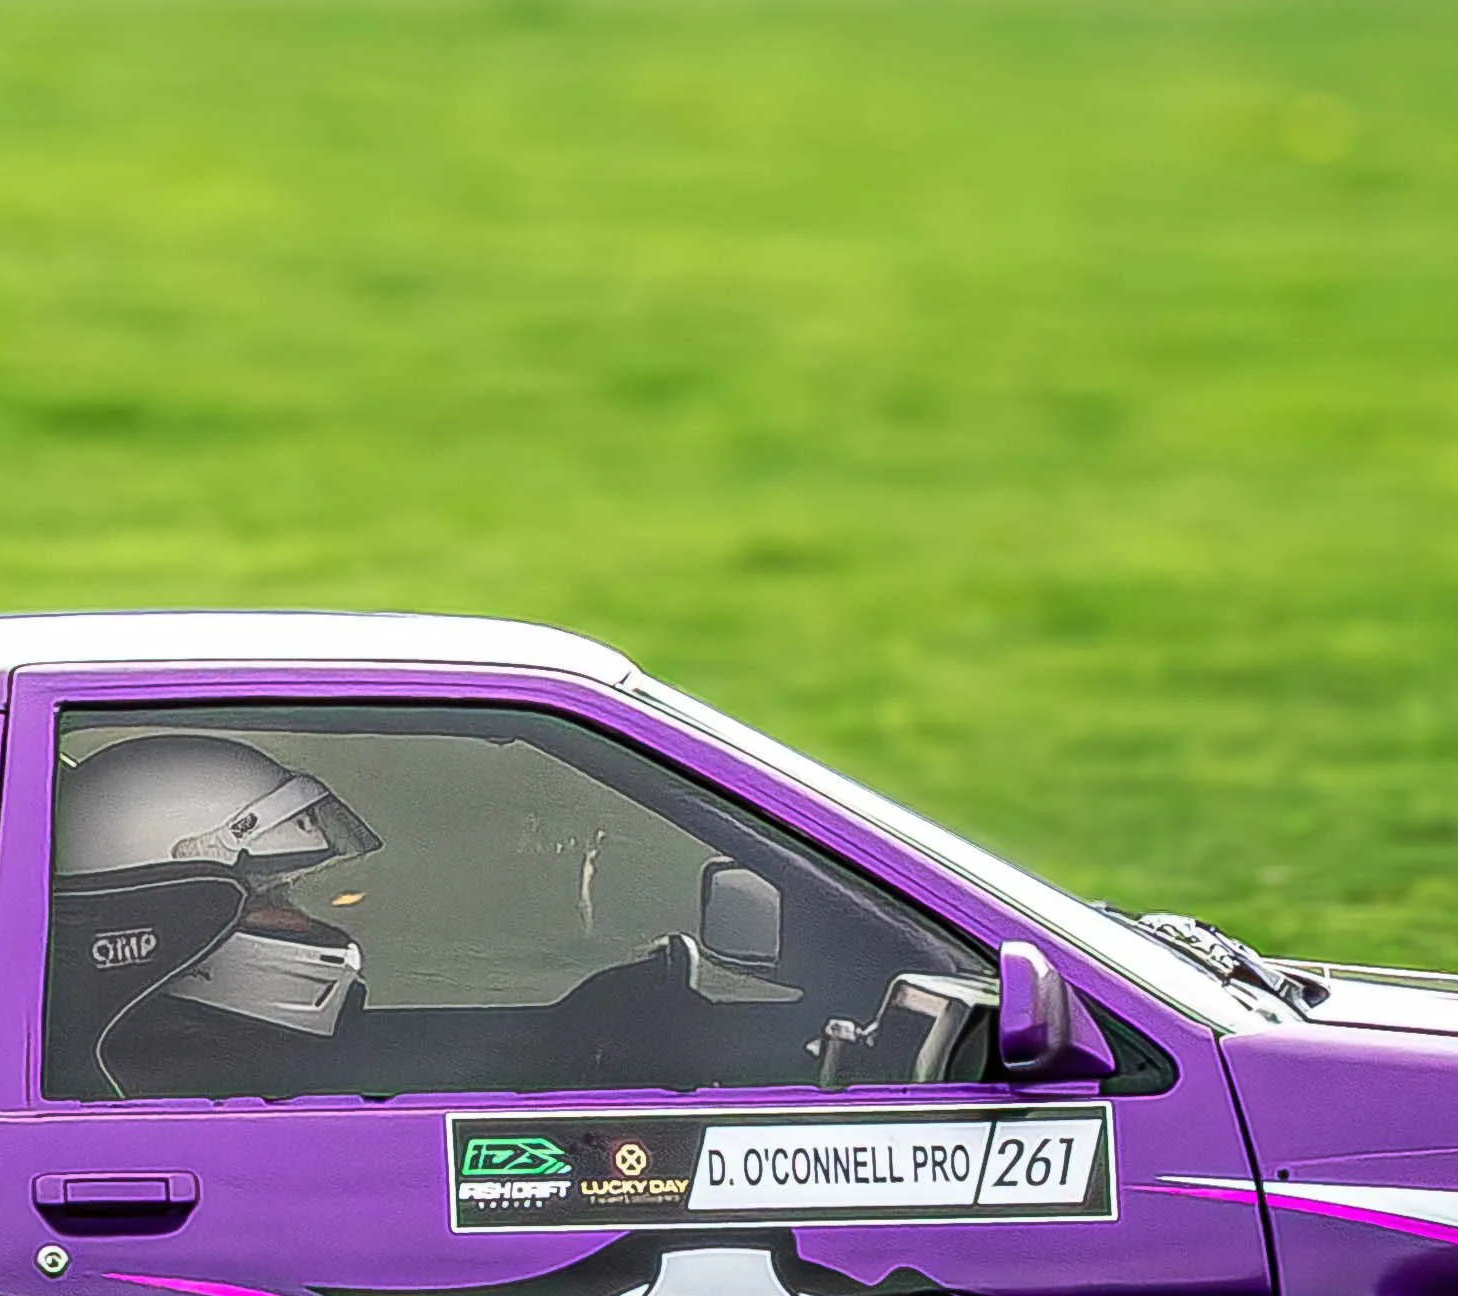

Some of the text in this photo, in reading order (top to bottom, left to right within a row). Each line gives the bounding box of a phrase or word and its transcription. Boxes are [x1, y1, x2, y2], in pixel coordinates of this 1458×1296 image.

[708, 1143, 971, 1187] D. O'CONNELL PRO
[992, 1137, 1076, 1188] 261
[581, 1179, 690, 1195] LUCKY DAY
